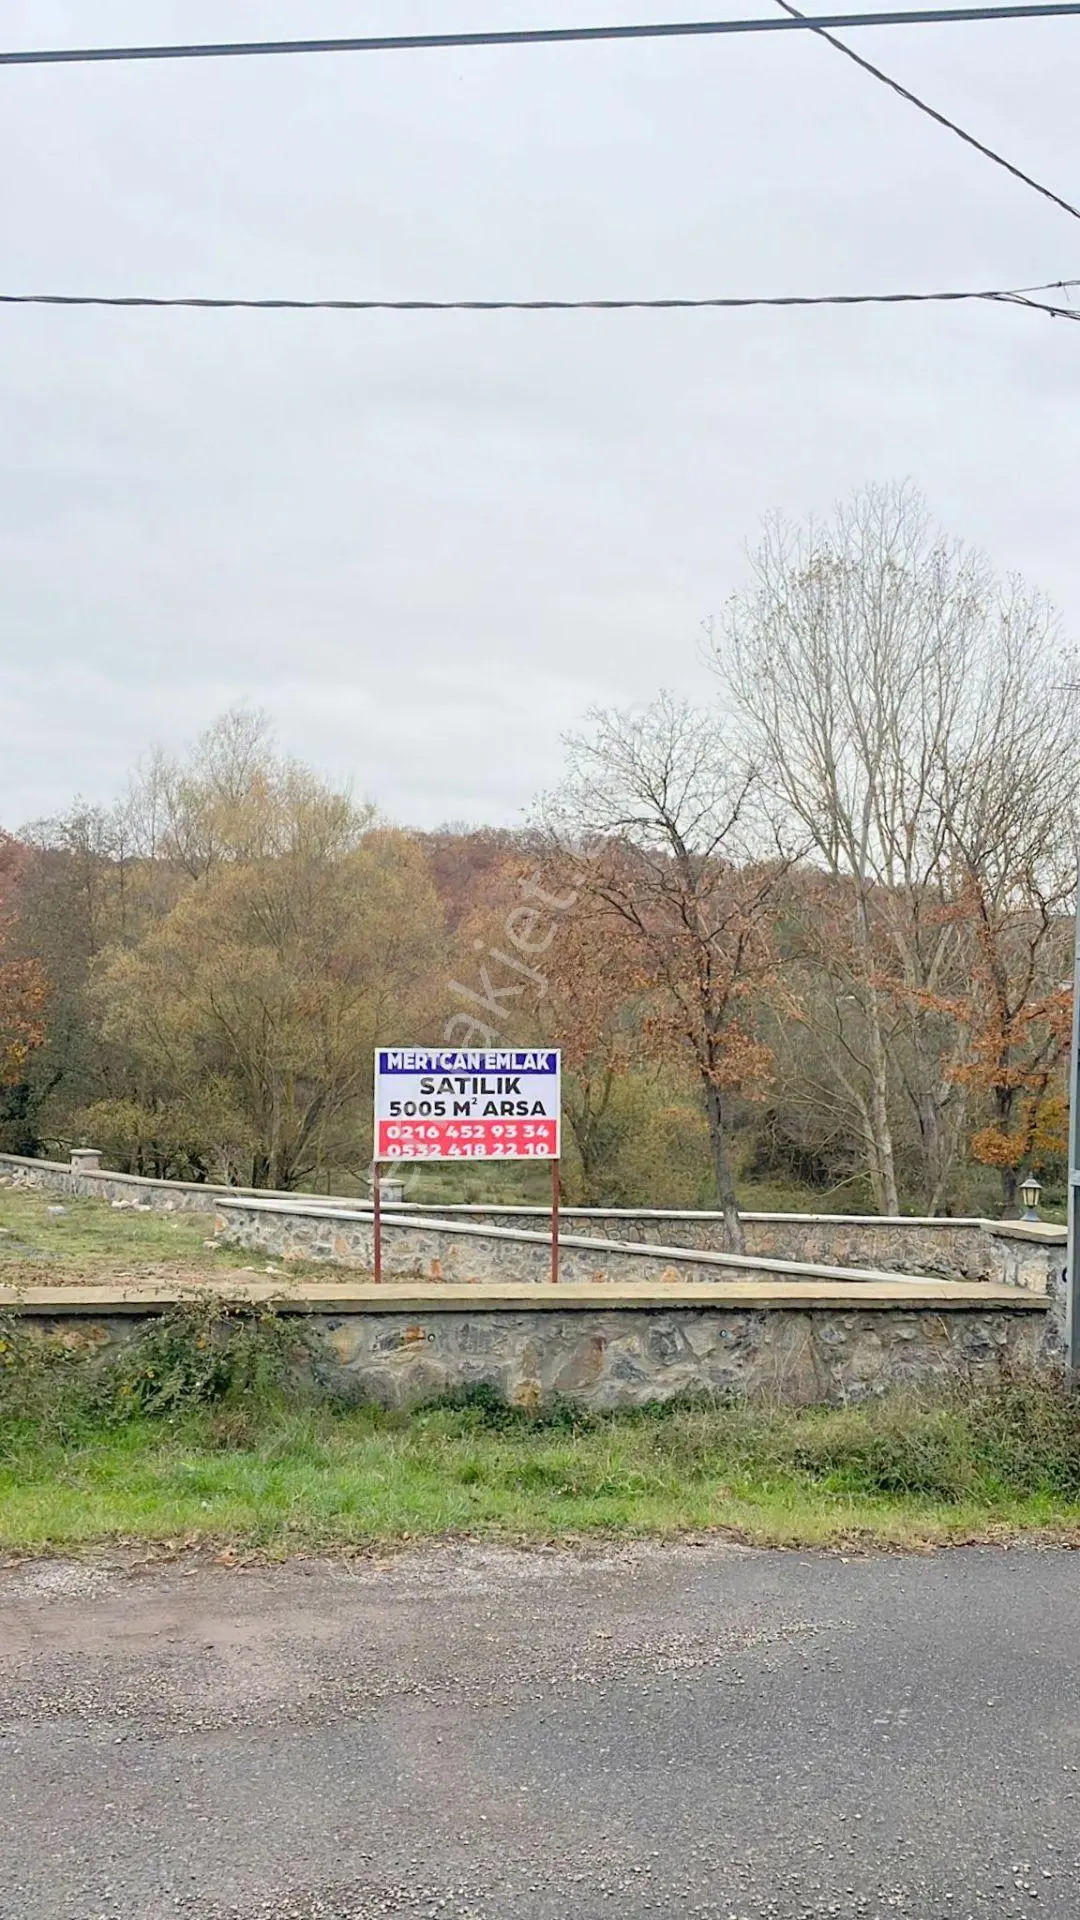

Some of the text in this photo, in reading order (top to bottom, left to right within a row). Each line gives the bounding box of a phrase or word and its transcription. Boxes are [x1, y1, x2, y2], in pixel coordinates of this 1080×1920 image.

[387, 1052, 550, 1070] MERTCAN EMLAK
[420, 1077, 521, 1095] SATILIK
[389, 1101, 446, 1117] 5005
[483, 1100, 547, 1116] ARSA
[386, 1125, 550, 1139] 0216 452 93 34
[387, 1142, 550, 1157] 0532 418 22 10
